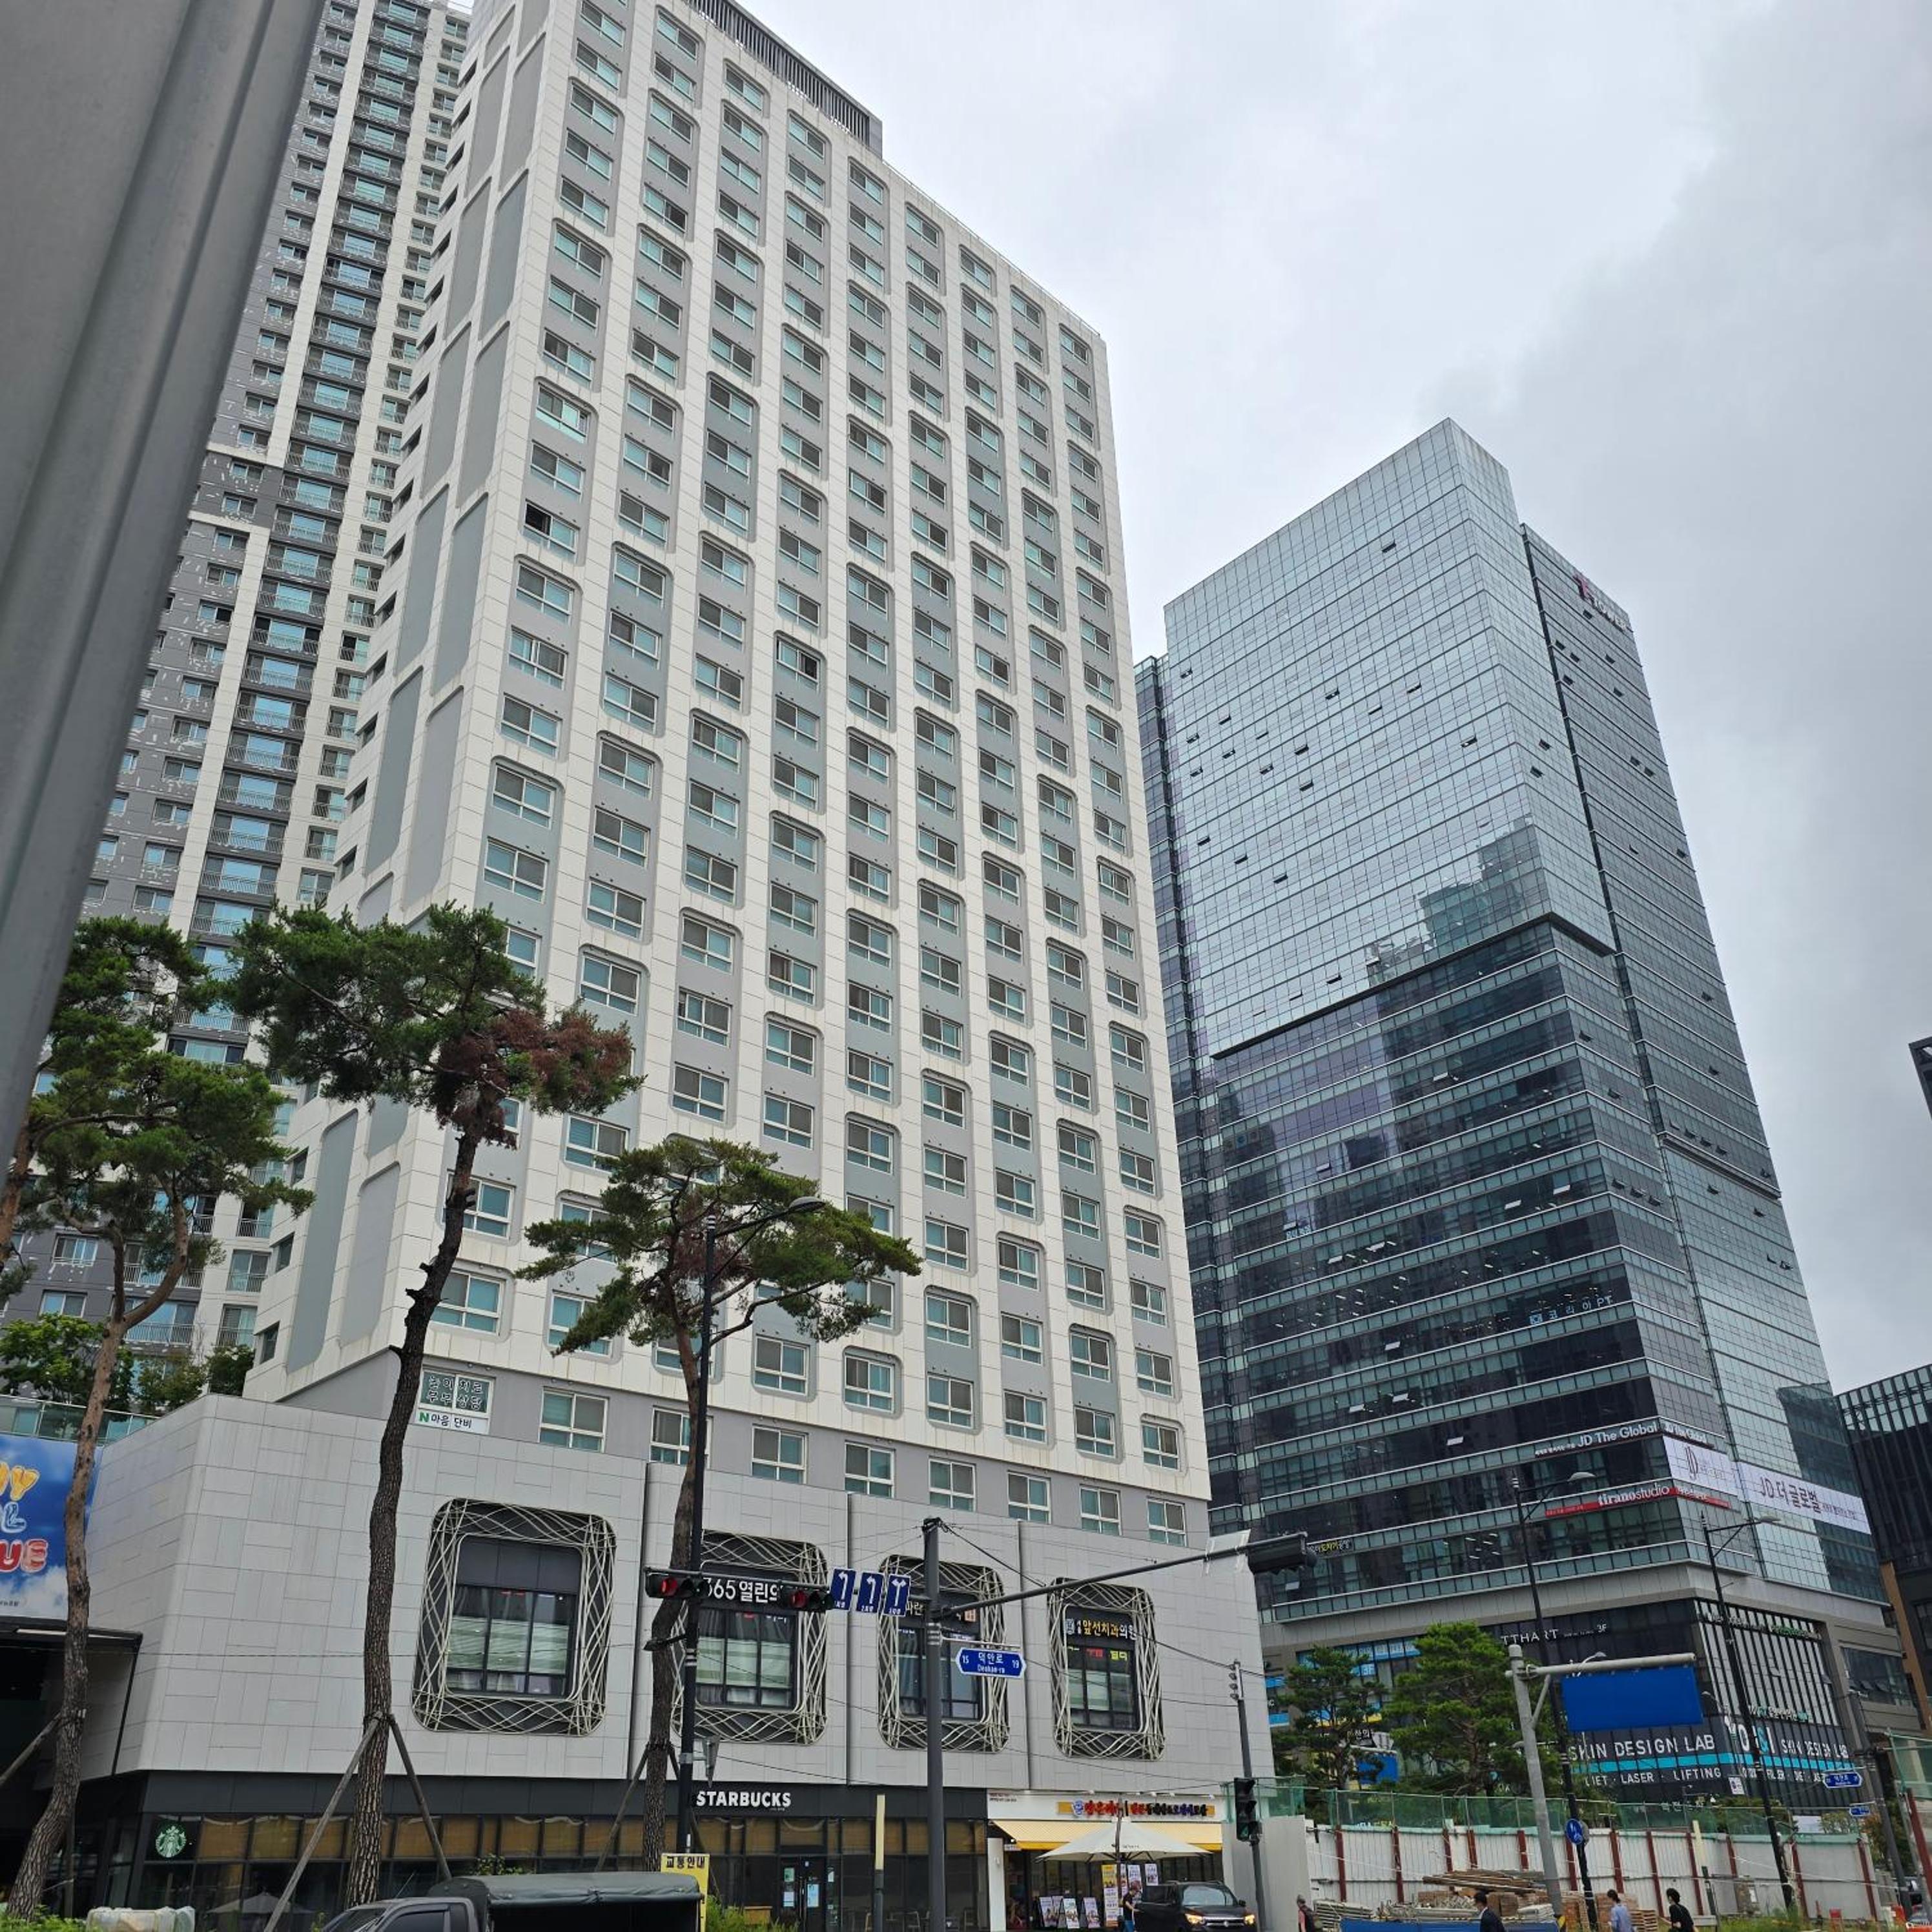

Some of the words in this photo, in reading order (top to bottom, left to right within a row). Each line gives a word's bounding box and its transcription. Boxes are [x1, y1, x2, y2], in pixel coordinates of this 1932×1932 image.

[431, 1414, 449, 1426] 마음
[1578, 1434, 1593, 1448] JD
[1594, 1432, 1618, 1444] The
[1619, 1421, 1658, 1439] Global
[1789, 1485, 1822, 1514] 글로벌
[1614, 1737, 1679, 1758] DESIGN
[1683, 1734, 1715, 1752] LAB
[1620, 1772, 1654, 1784] LASER
[1673, 1767, 1721, 1782] LIFTING
[696, 1790, 792, 1807] STARBUCKS
